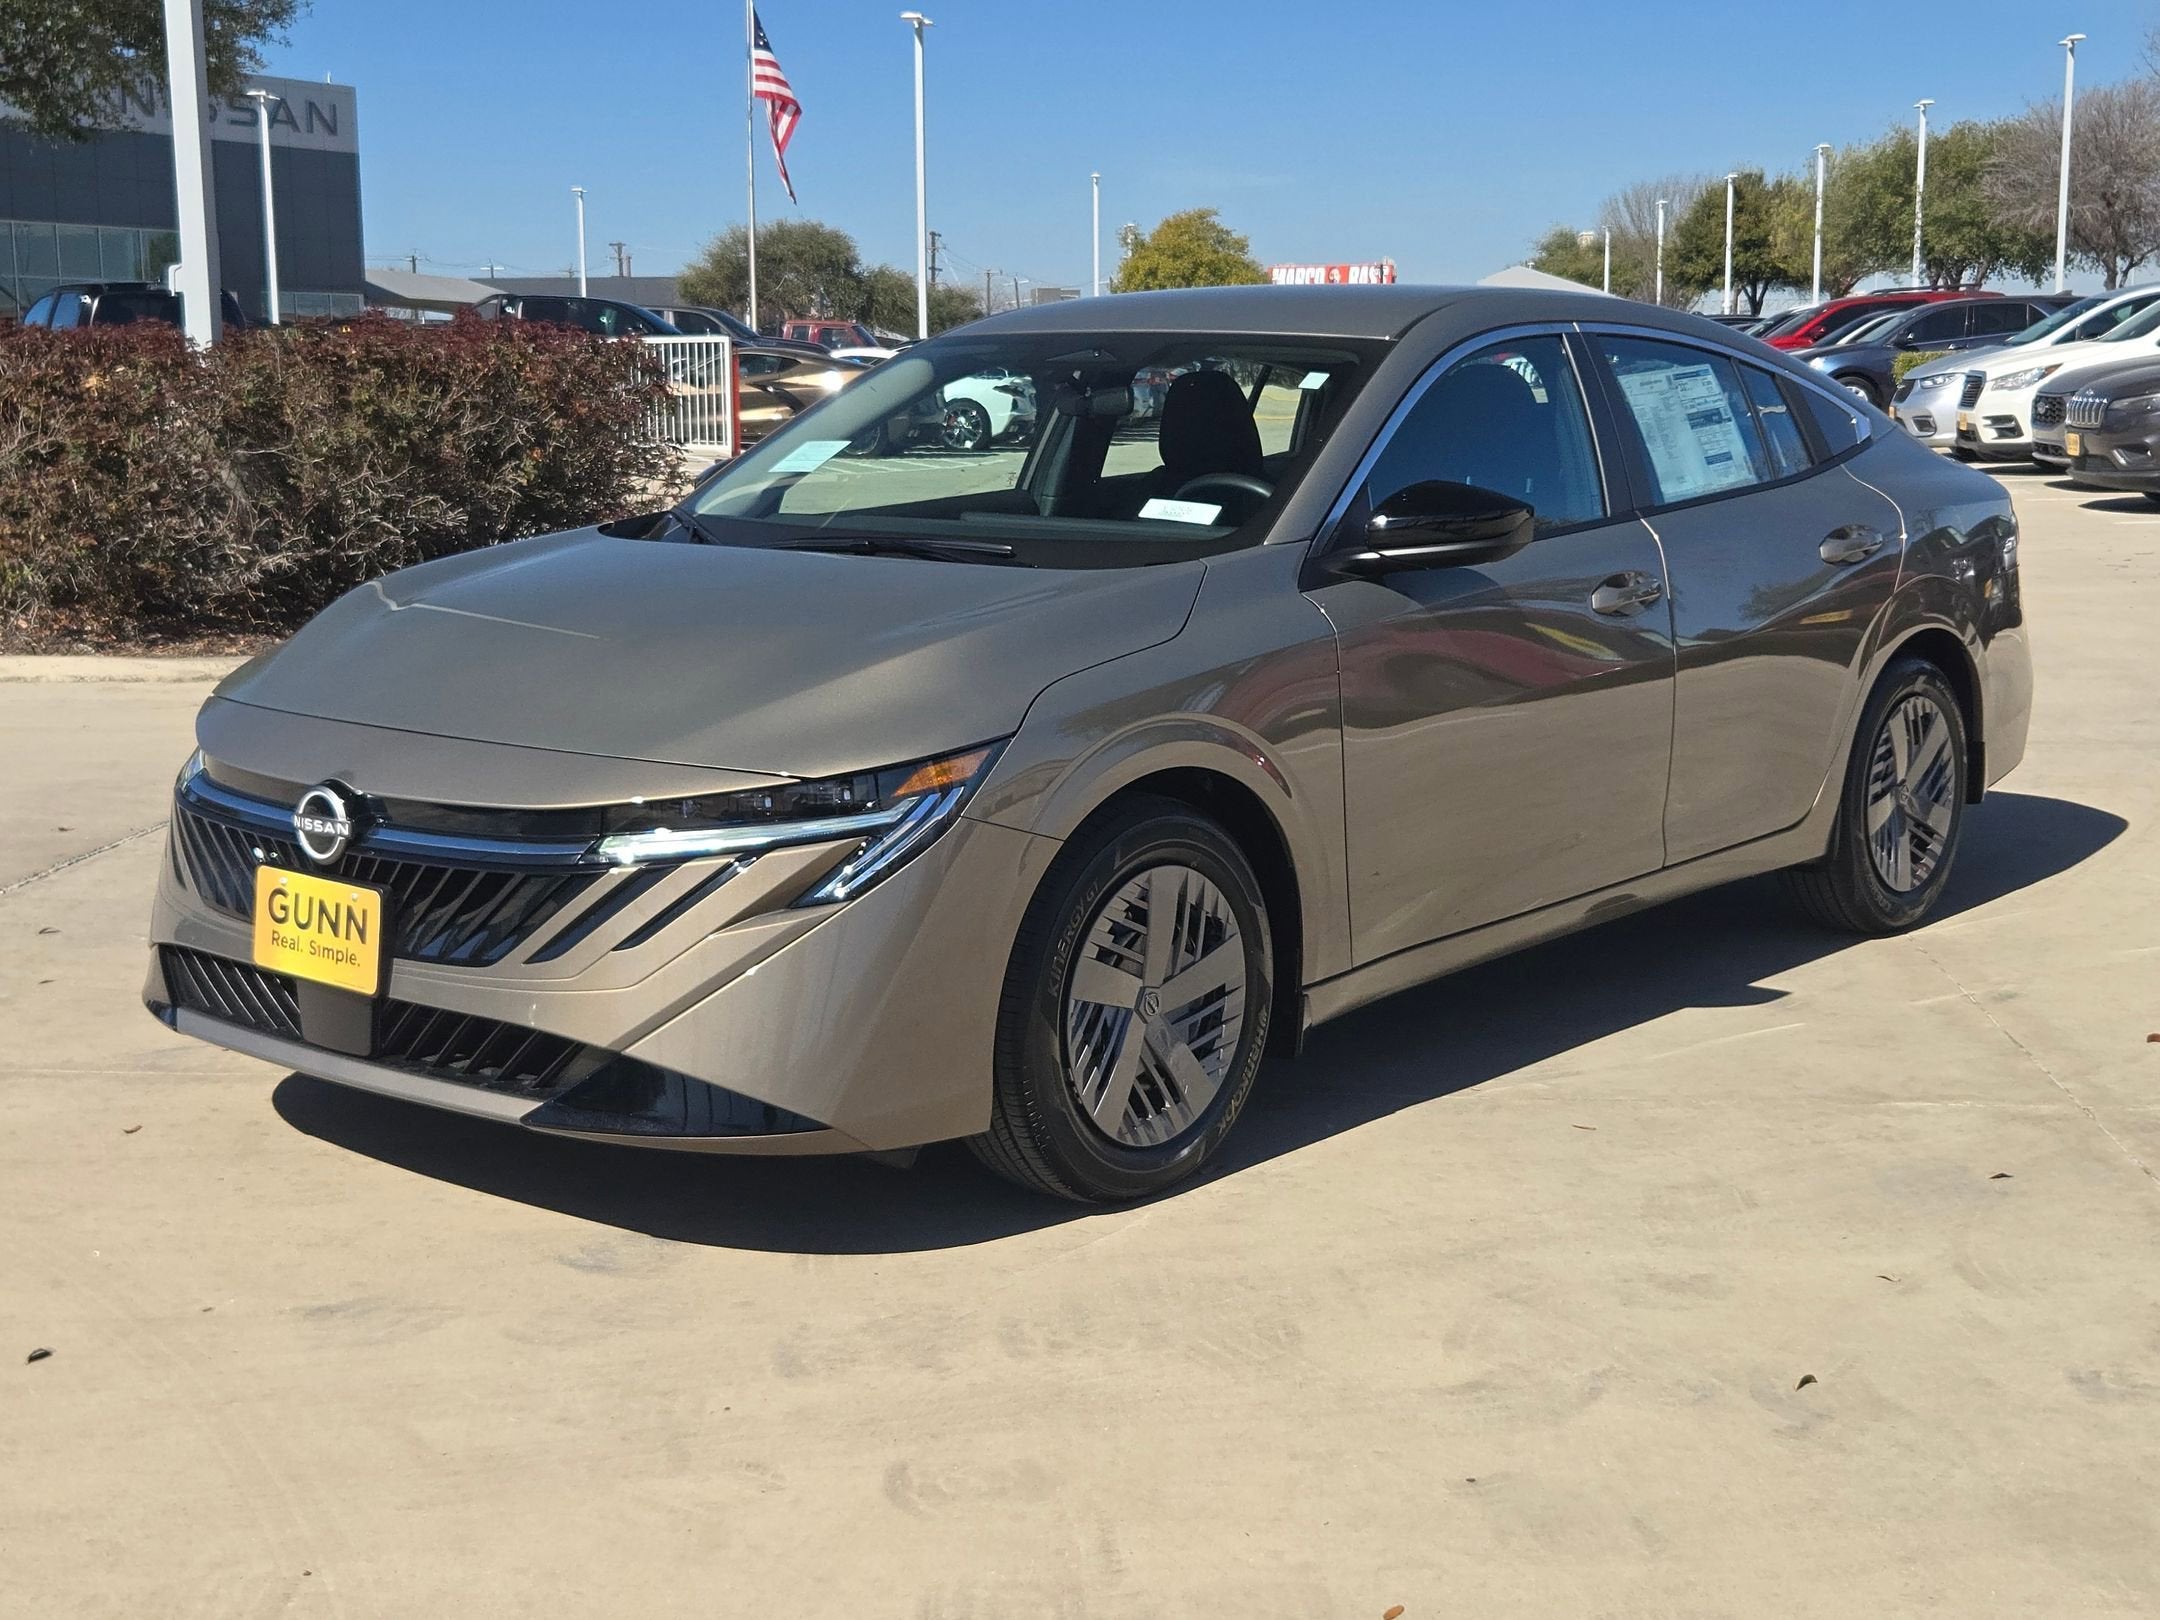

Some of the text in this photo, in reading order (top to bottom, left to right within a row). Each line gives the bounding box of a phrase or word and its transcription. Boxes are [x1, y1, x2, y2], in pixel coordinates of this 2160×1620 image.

[294, 816, 349, 836] NISSAN
[268, 887, 367, 944] GUNN
[271, 929, 303, 953] Real.
